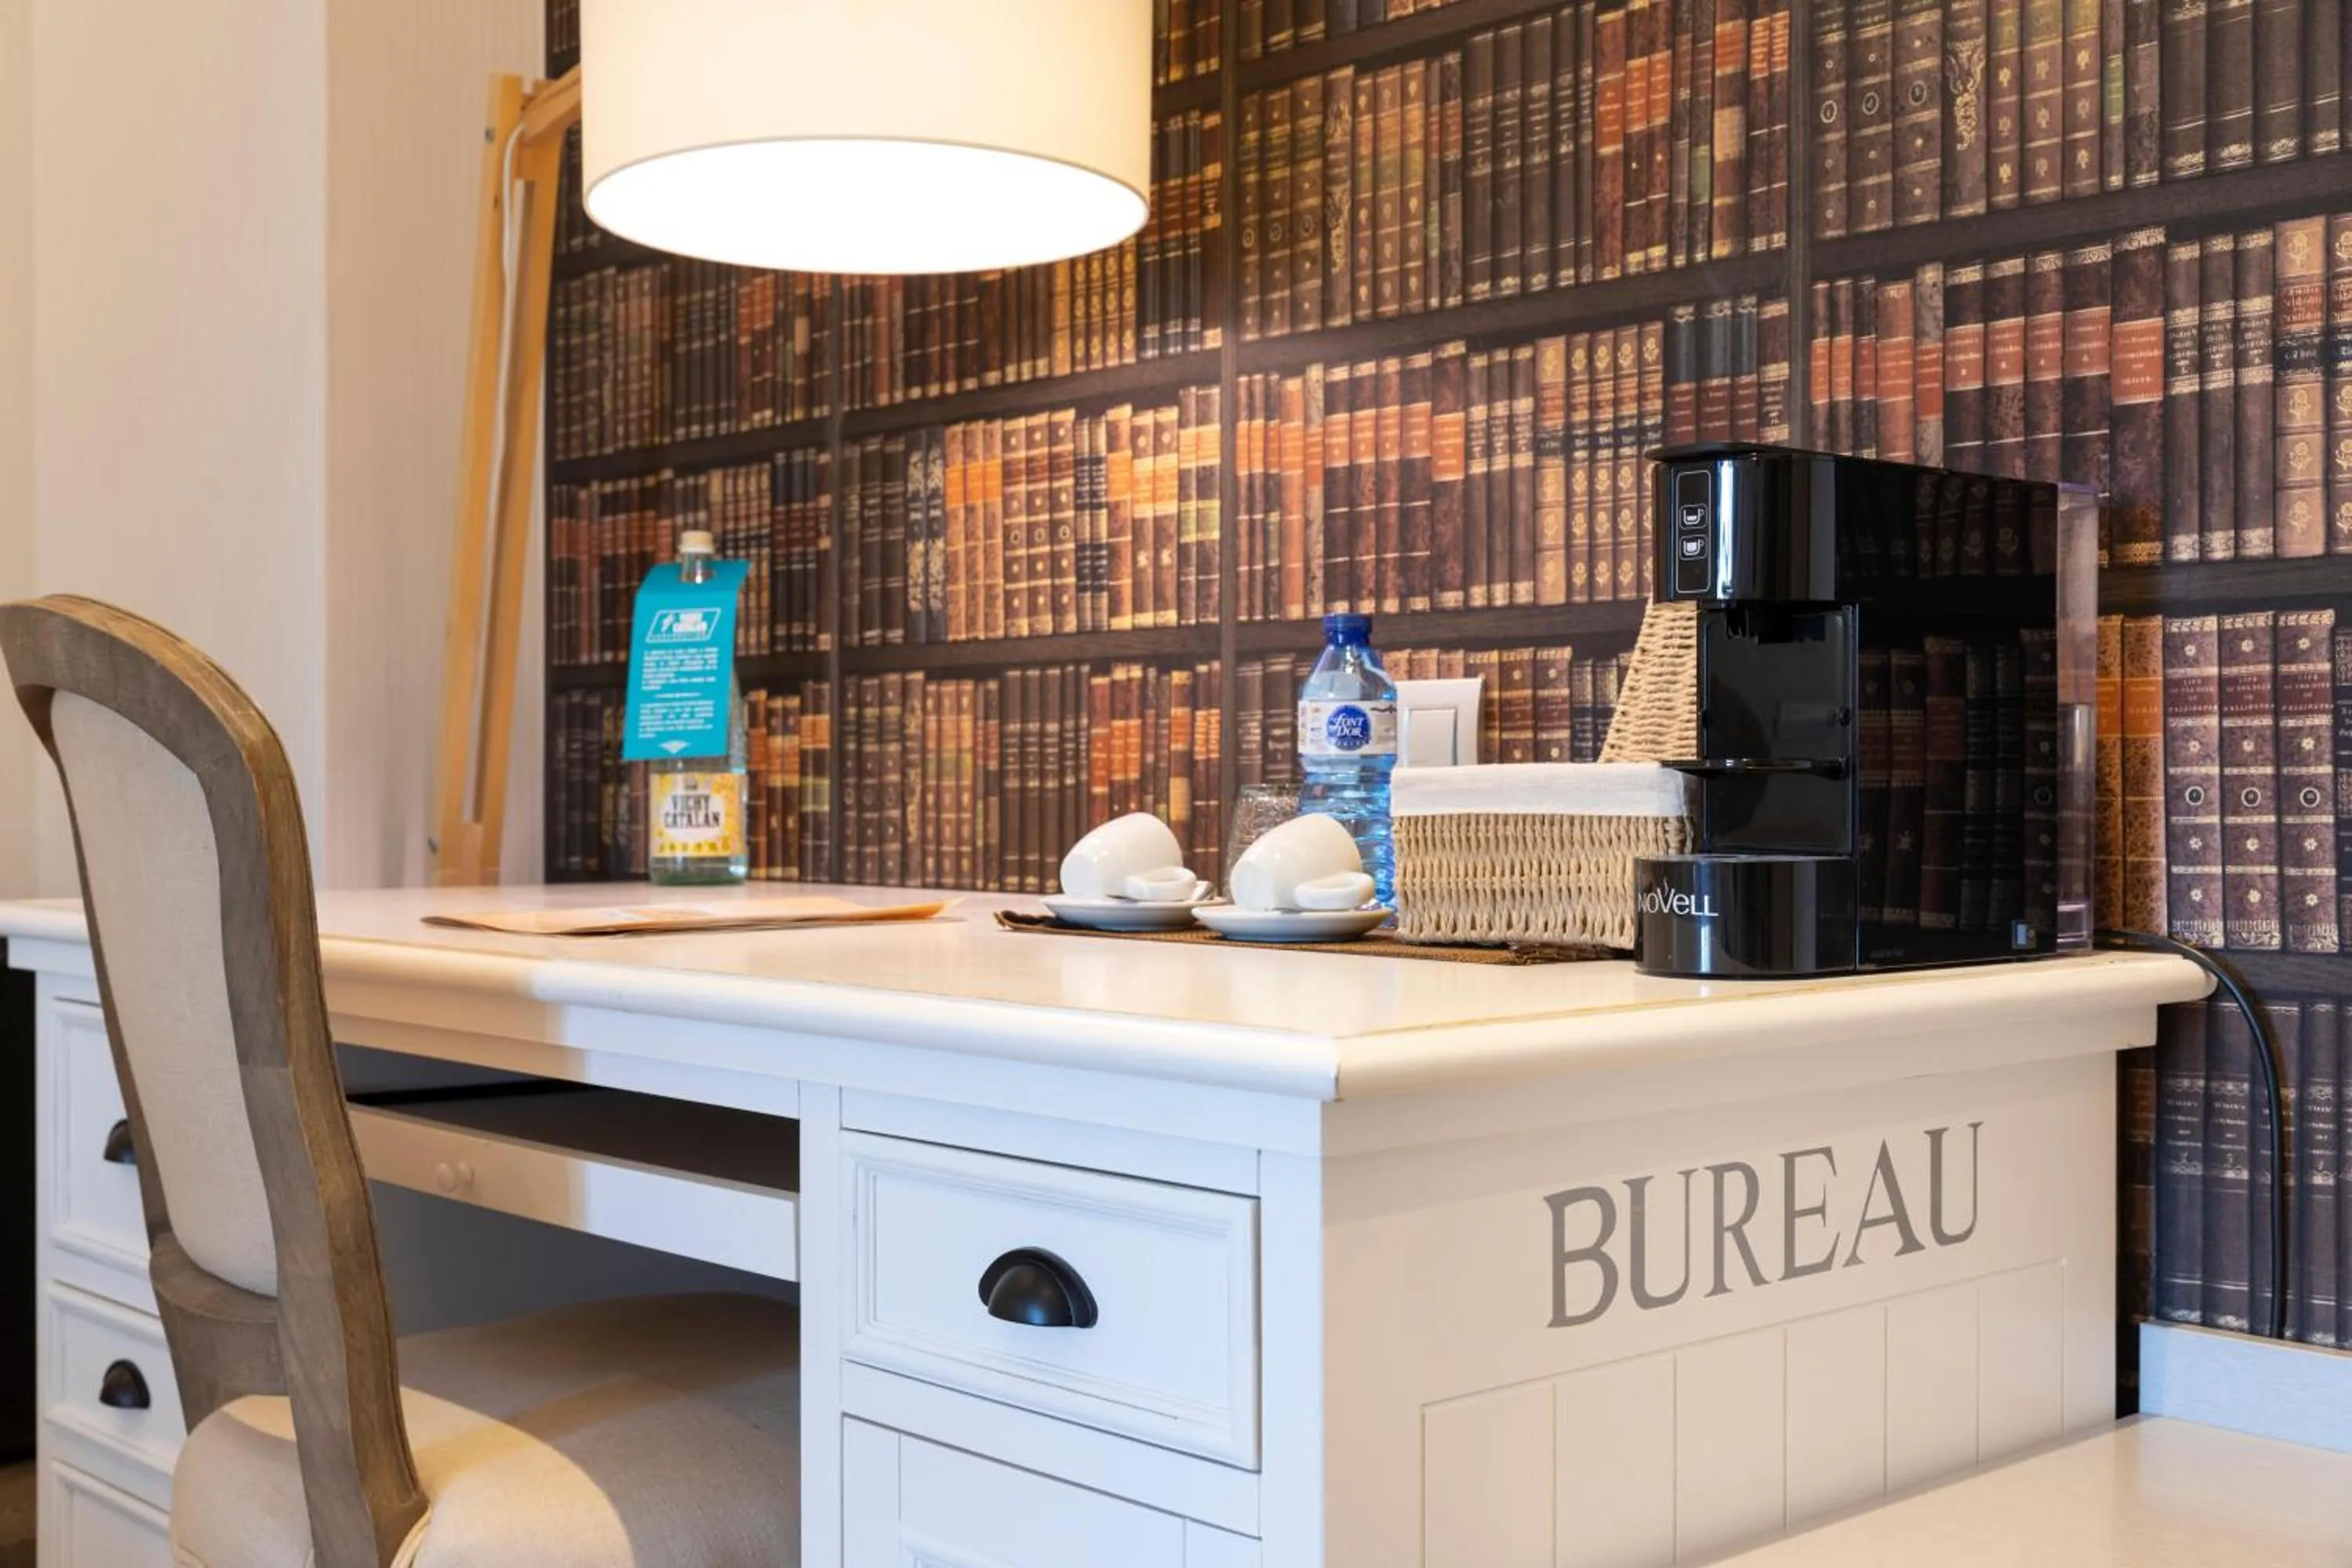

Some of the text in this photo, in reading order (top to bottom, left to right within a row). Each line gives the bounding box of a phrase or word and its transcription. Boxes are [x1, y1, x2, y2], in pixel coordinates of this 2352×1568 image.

[672, 793, 710, 811] VICHY
[663, 811, 720, 828] CATALAN
[1542, 1121, 1984, 1328] BUREAU
